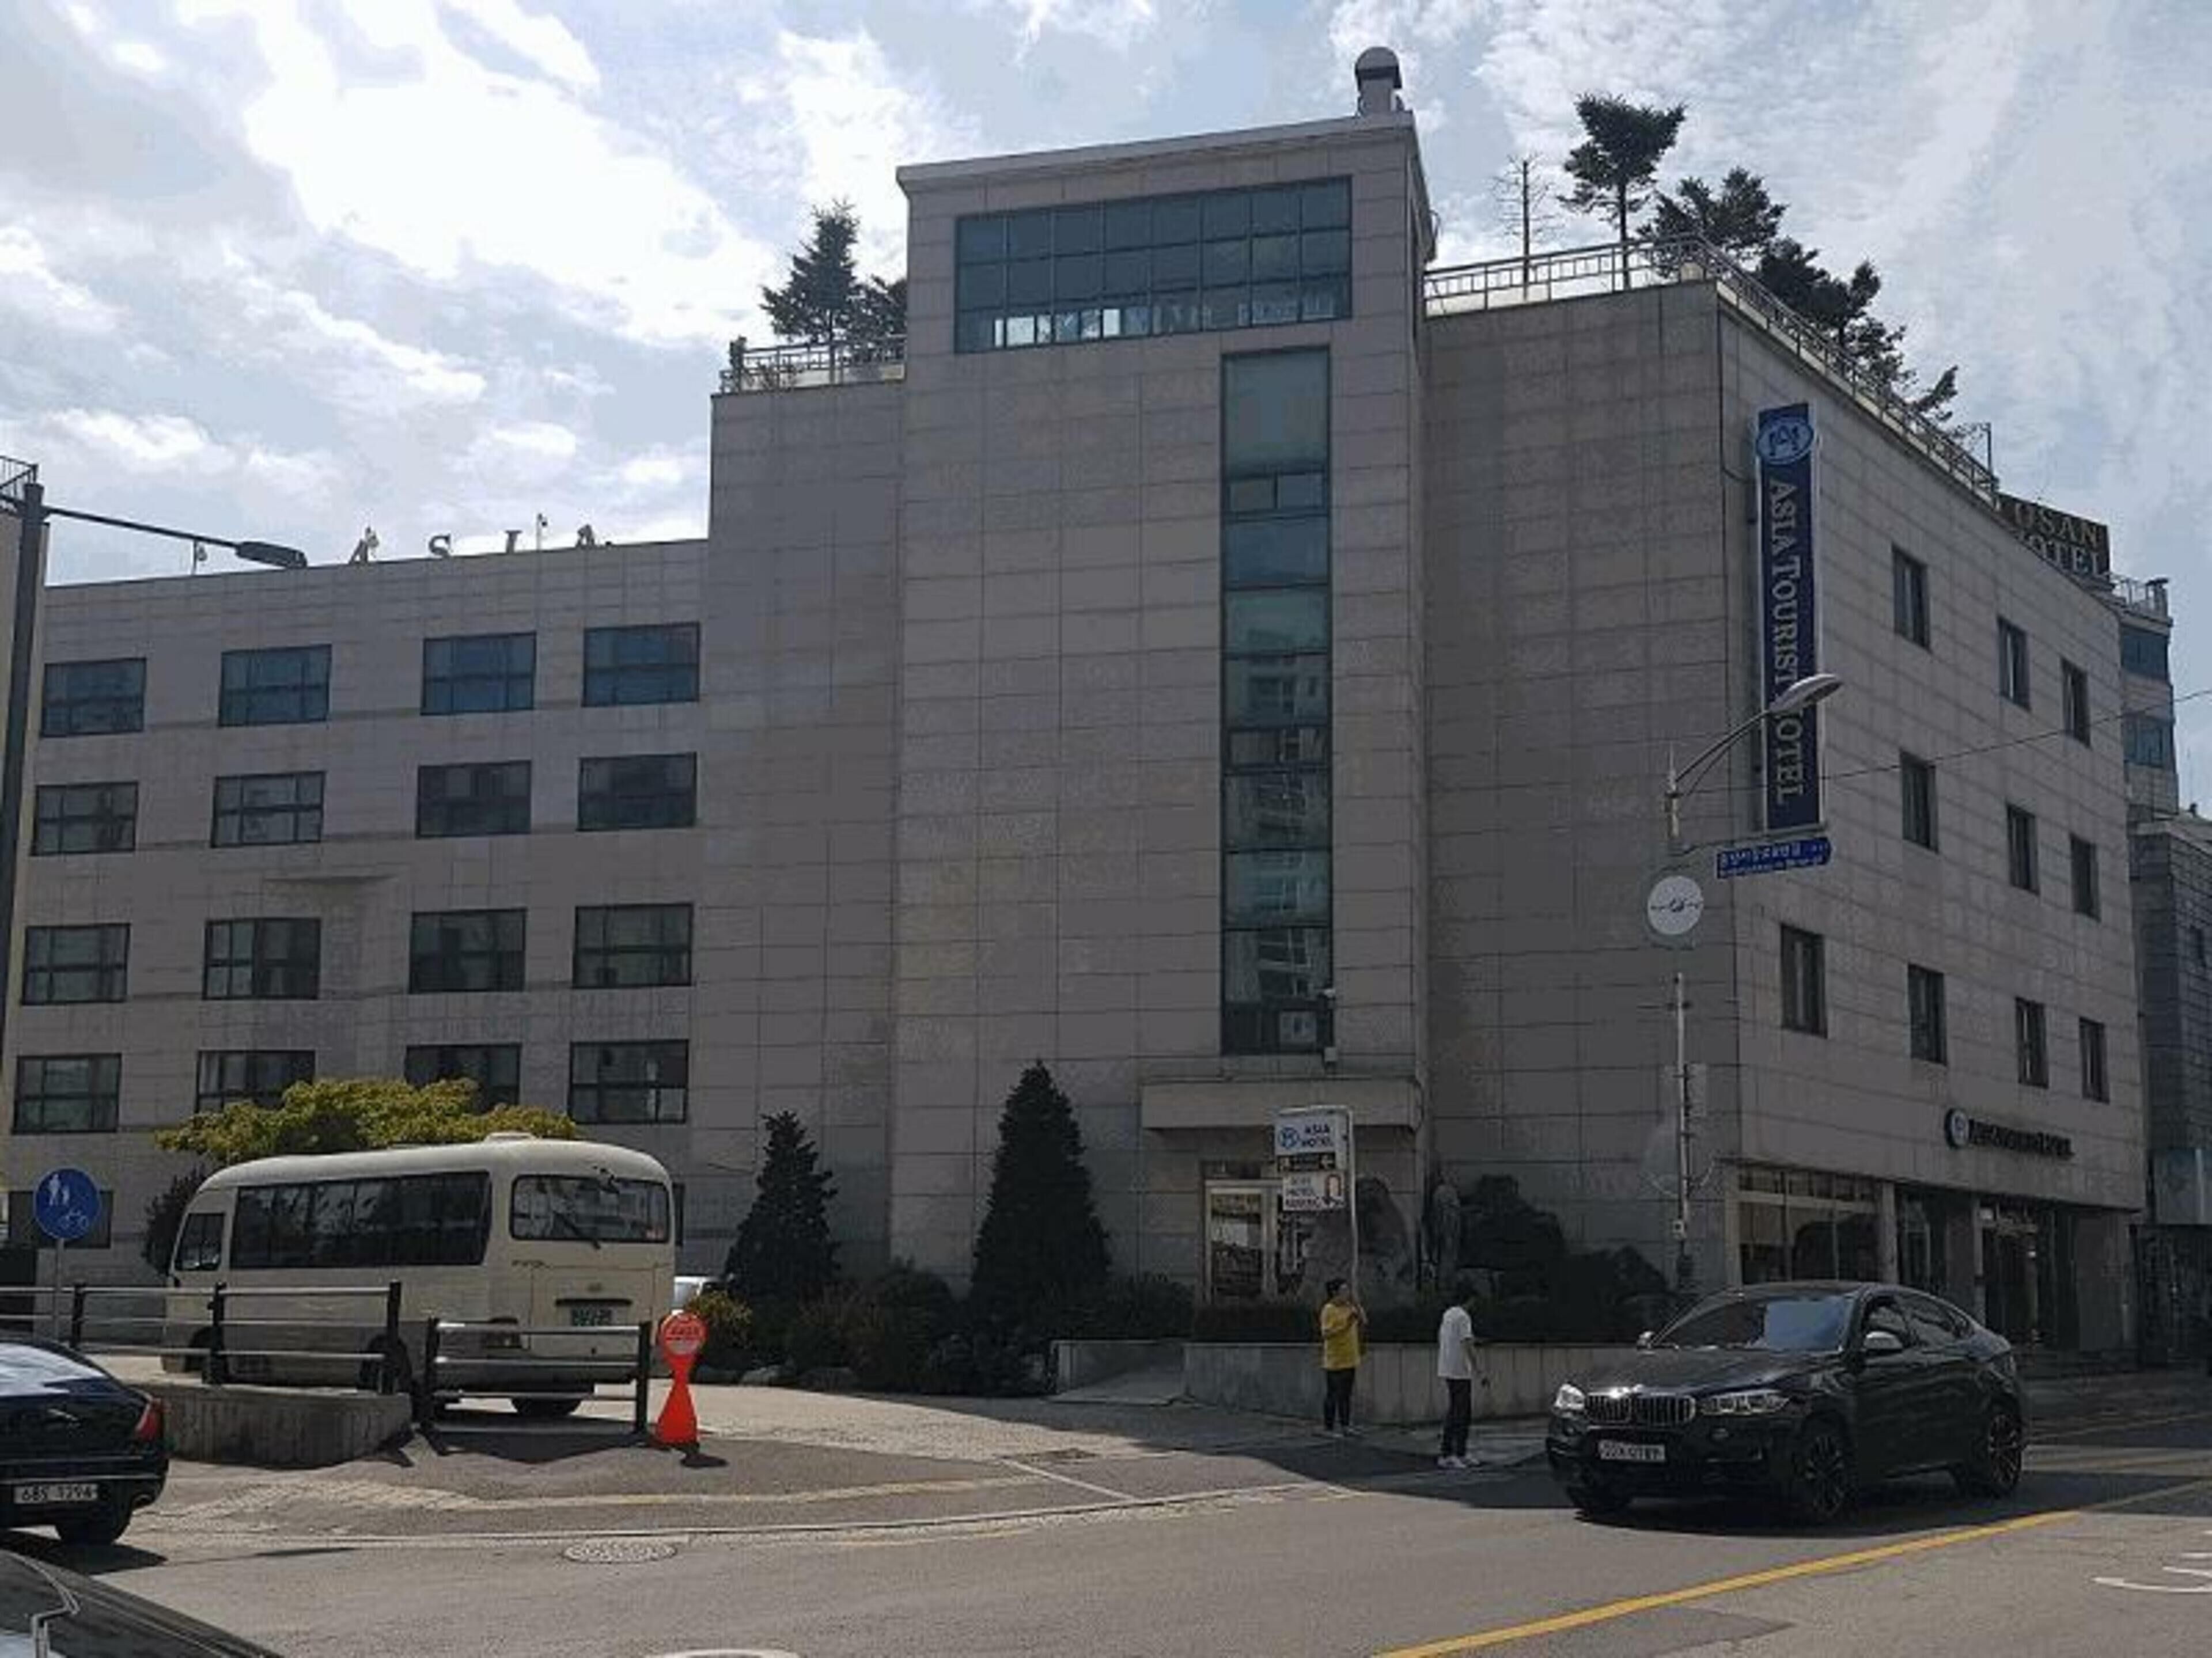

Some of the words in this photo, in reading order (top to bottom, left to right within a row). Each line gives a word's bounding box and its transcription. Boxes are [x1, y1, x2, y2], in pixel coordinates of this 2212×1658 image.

[1769, 479, 1799, 556] ASIA
[1771, 555, 1802, 685] TOURIST
[1774, 693, 1805, 805] OTEL
